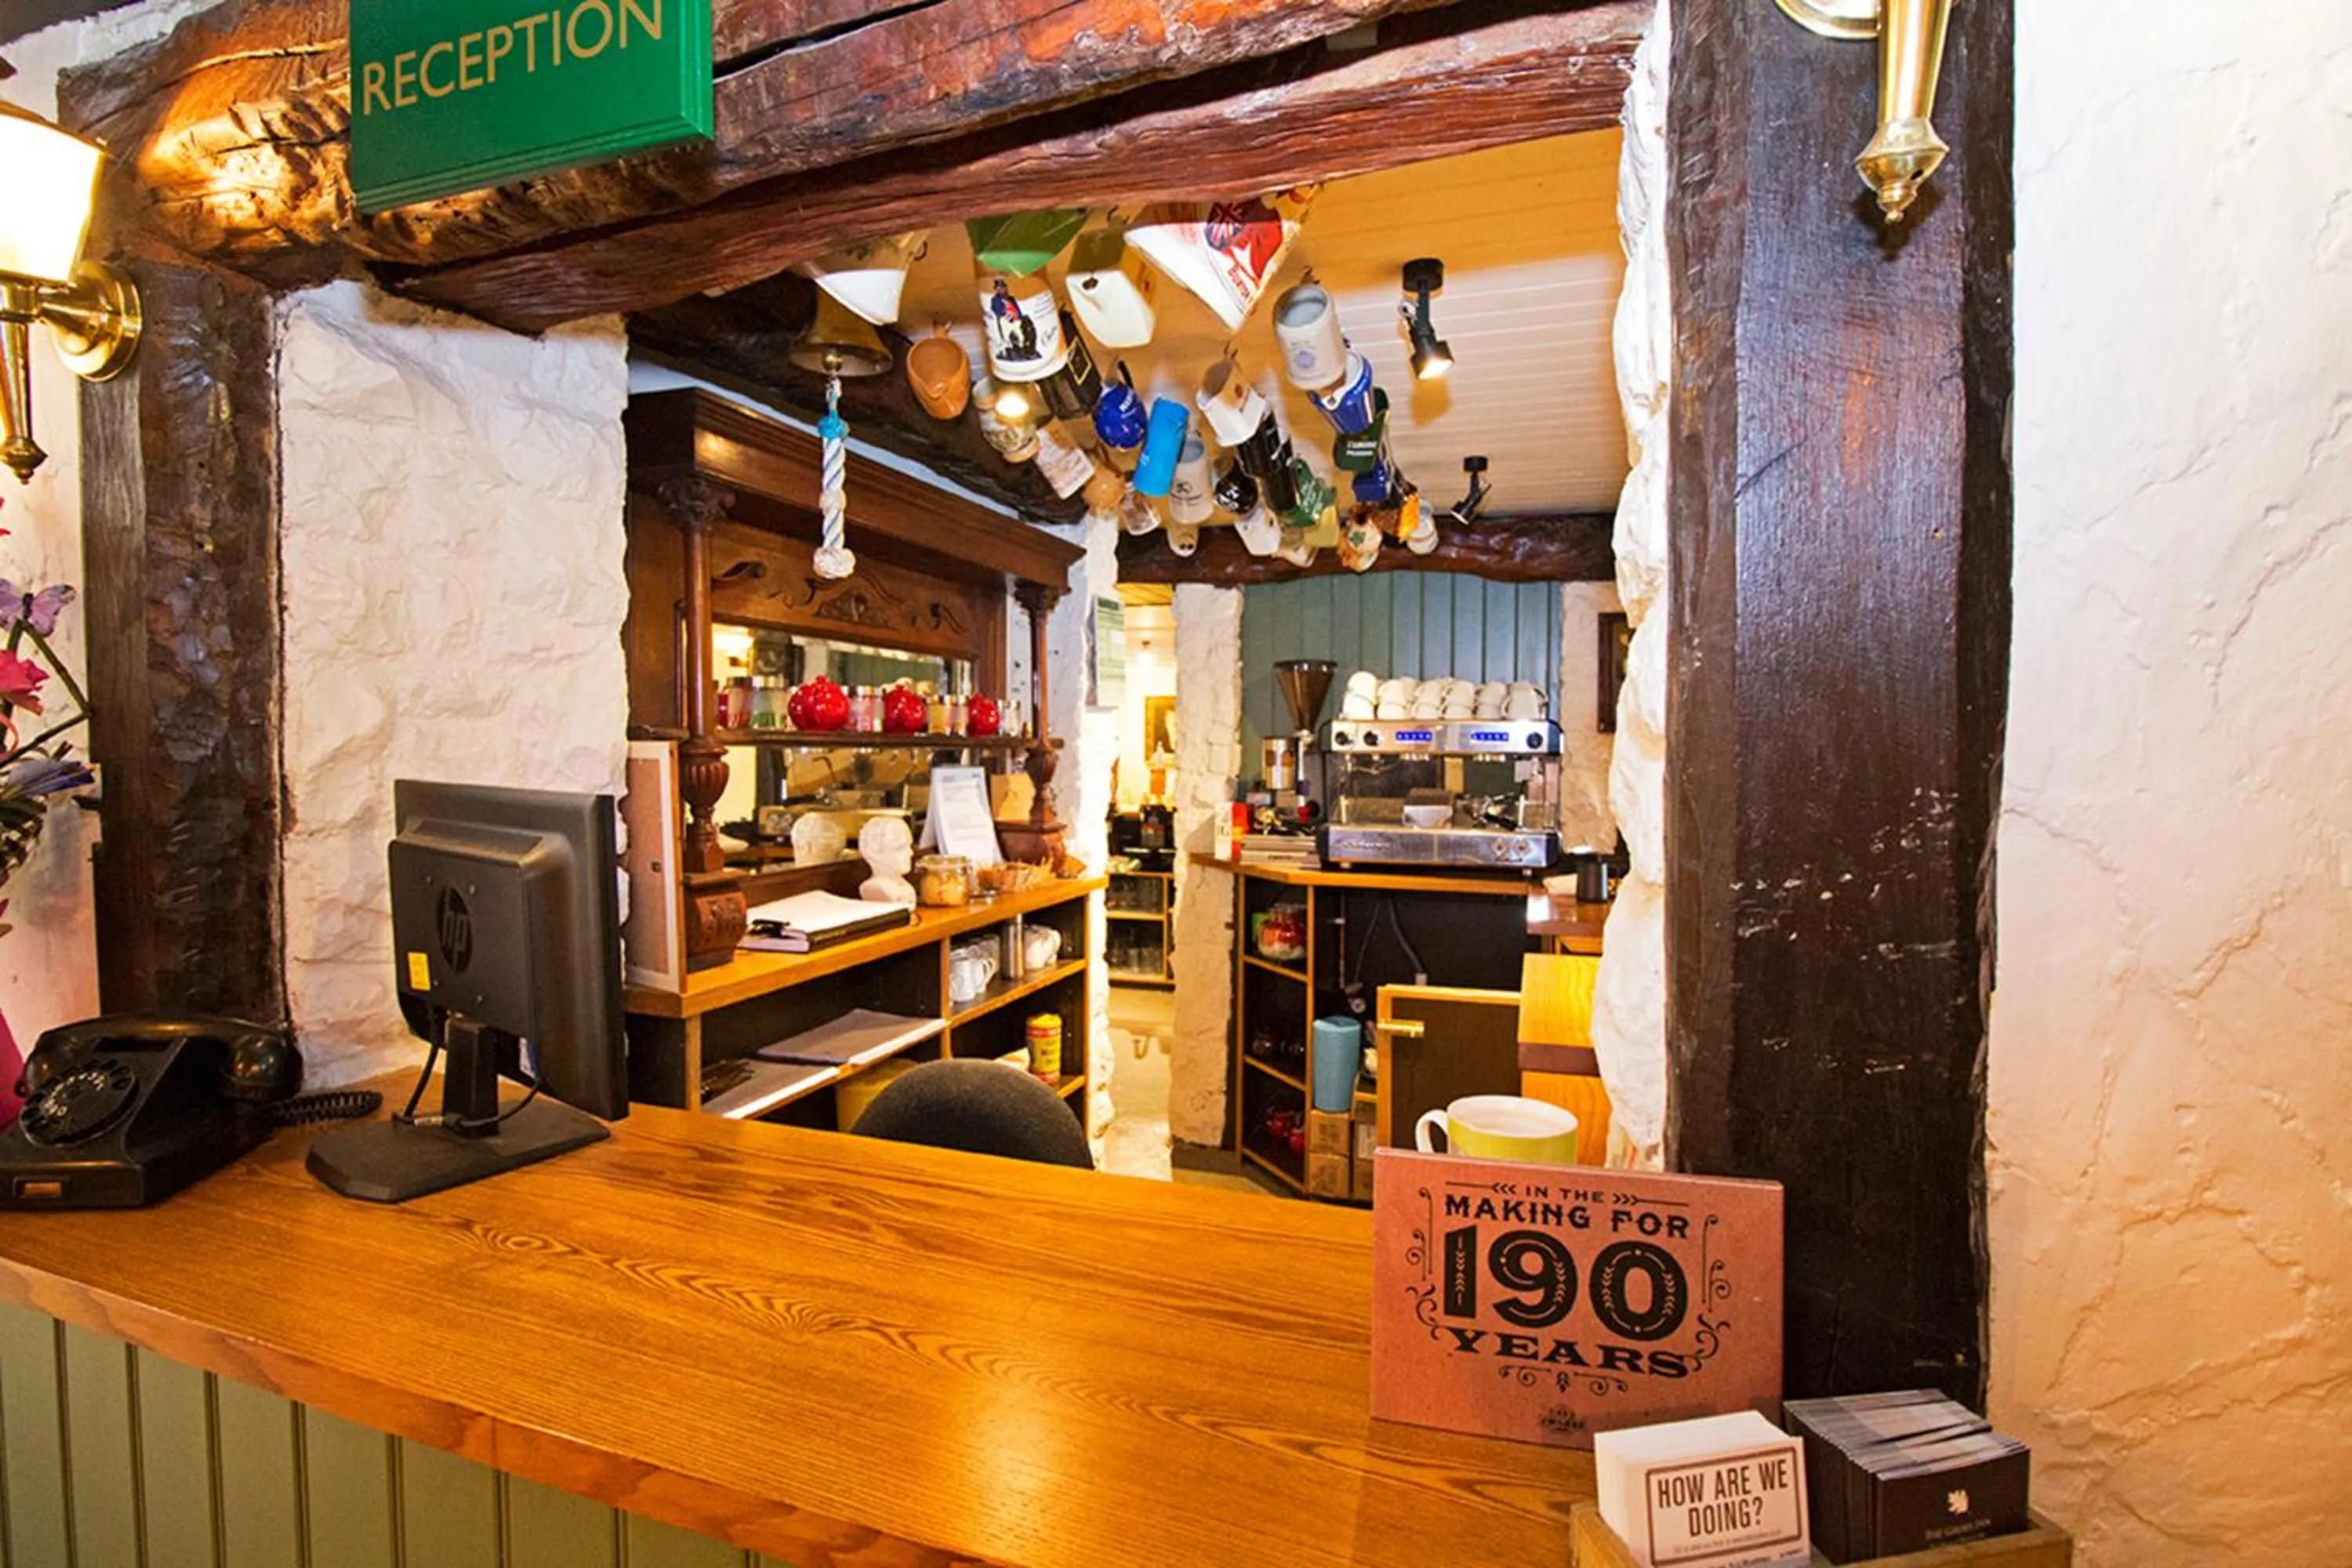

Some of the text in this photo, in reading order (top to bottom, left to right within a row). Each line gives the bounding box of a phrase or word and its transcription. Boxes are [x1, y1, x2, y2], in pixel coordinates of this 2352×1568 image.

[362, 0, 662, 115] RECEPTION
[442, 887, 468, 974] hp
[1444, 1193, 1690, 1240] MAKING FOR
[1525, 1185, 1604, 1203] IN THE
[1443, 1225, 1689, 1341] 190
[1446, 1325, 1689, 1379] YEARS
[1657, 1458, 1788, 1509] HOW ARE WE
[1687, 1496, 1765, 1537] DOING?
